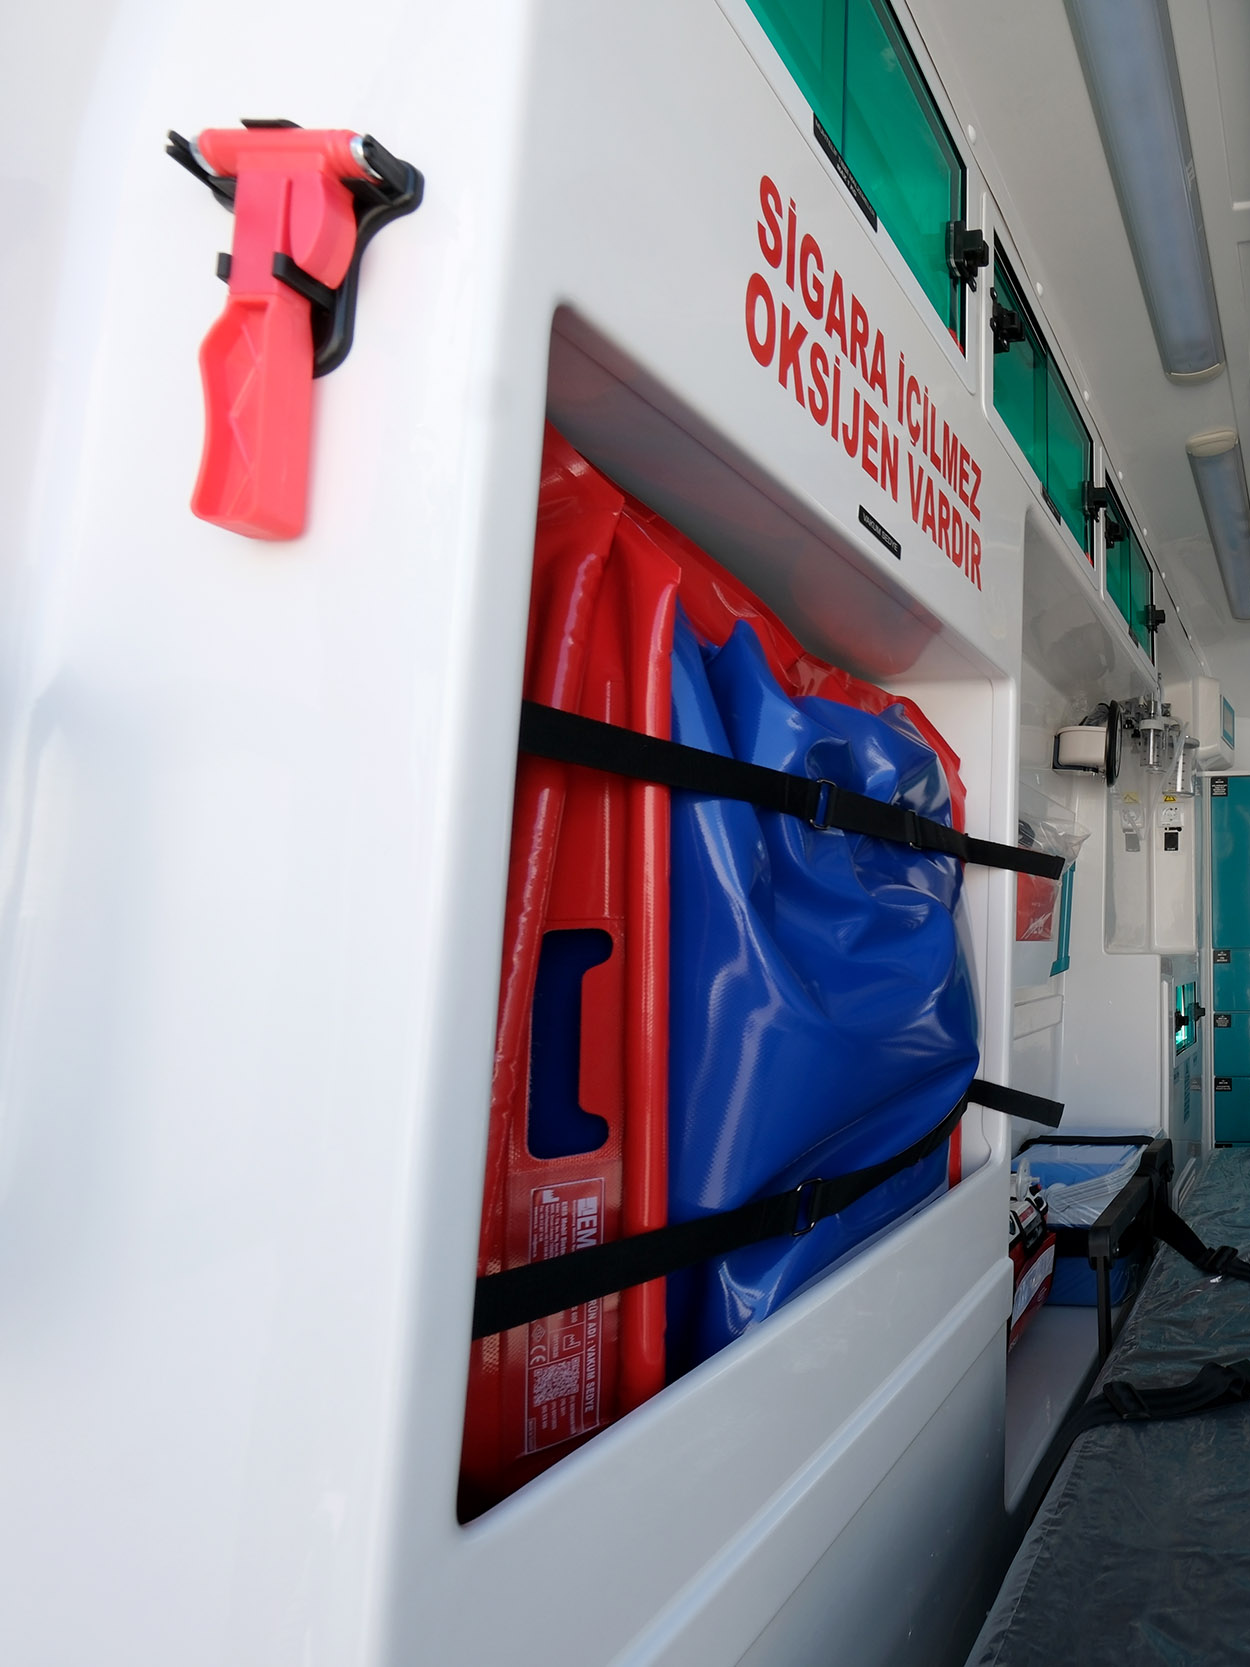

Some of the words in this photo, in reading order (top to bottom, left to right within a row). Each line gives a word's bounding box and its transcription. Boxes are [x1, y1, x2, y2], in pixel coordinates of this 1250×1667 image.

[757, 175, 888, 407] SİGARA
[897, 351, 982, 523] İÇİLMEZ
[745, 272, 899, 503] OKSİJEN
[907, 451, 982, 591] VARDIR
[576, 1214, 598, 1250] EM
[587, 1299, 598, 1321] RÜN
[586, 1321, 597, 1339] ADI
[585, 1344, 597, 1381] VAKUM
[584, 1382, 596, 1413] SEDYE
